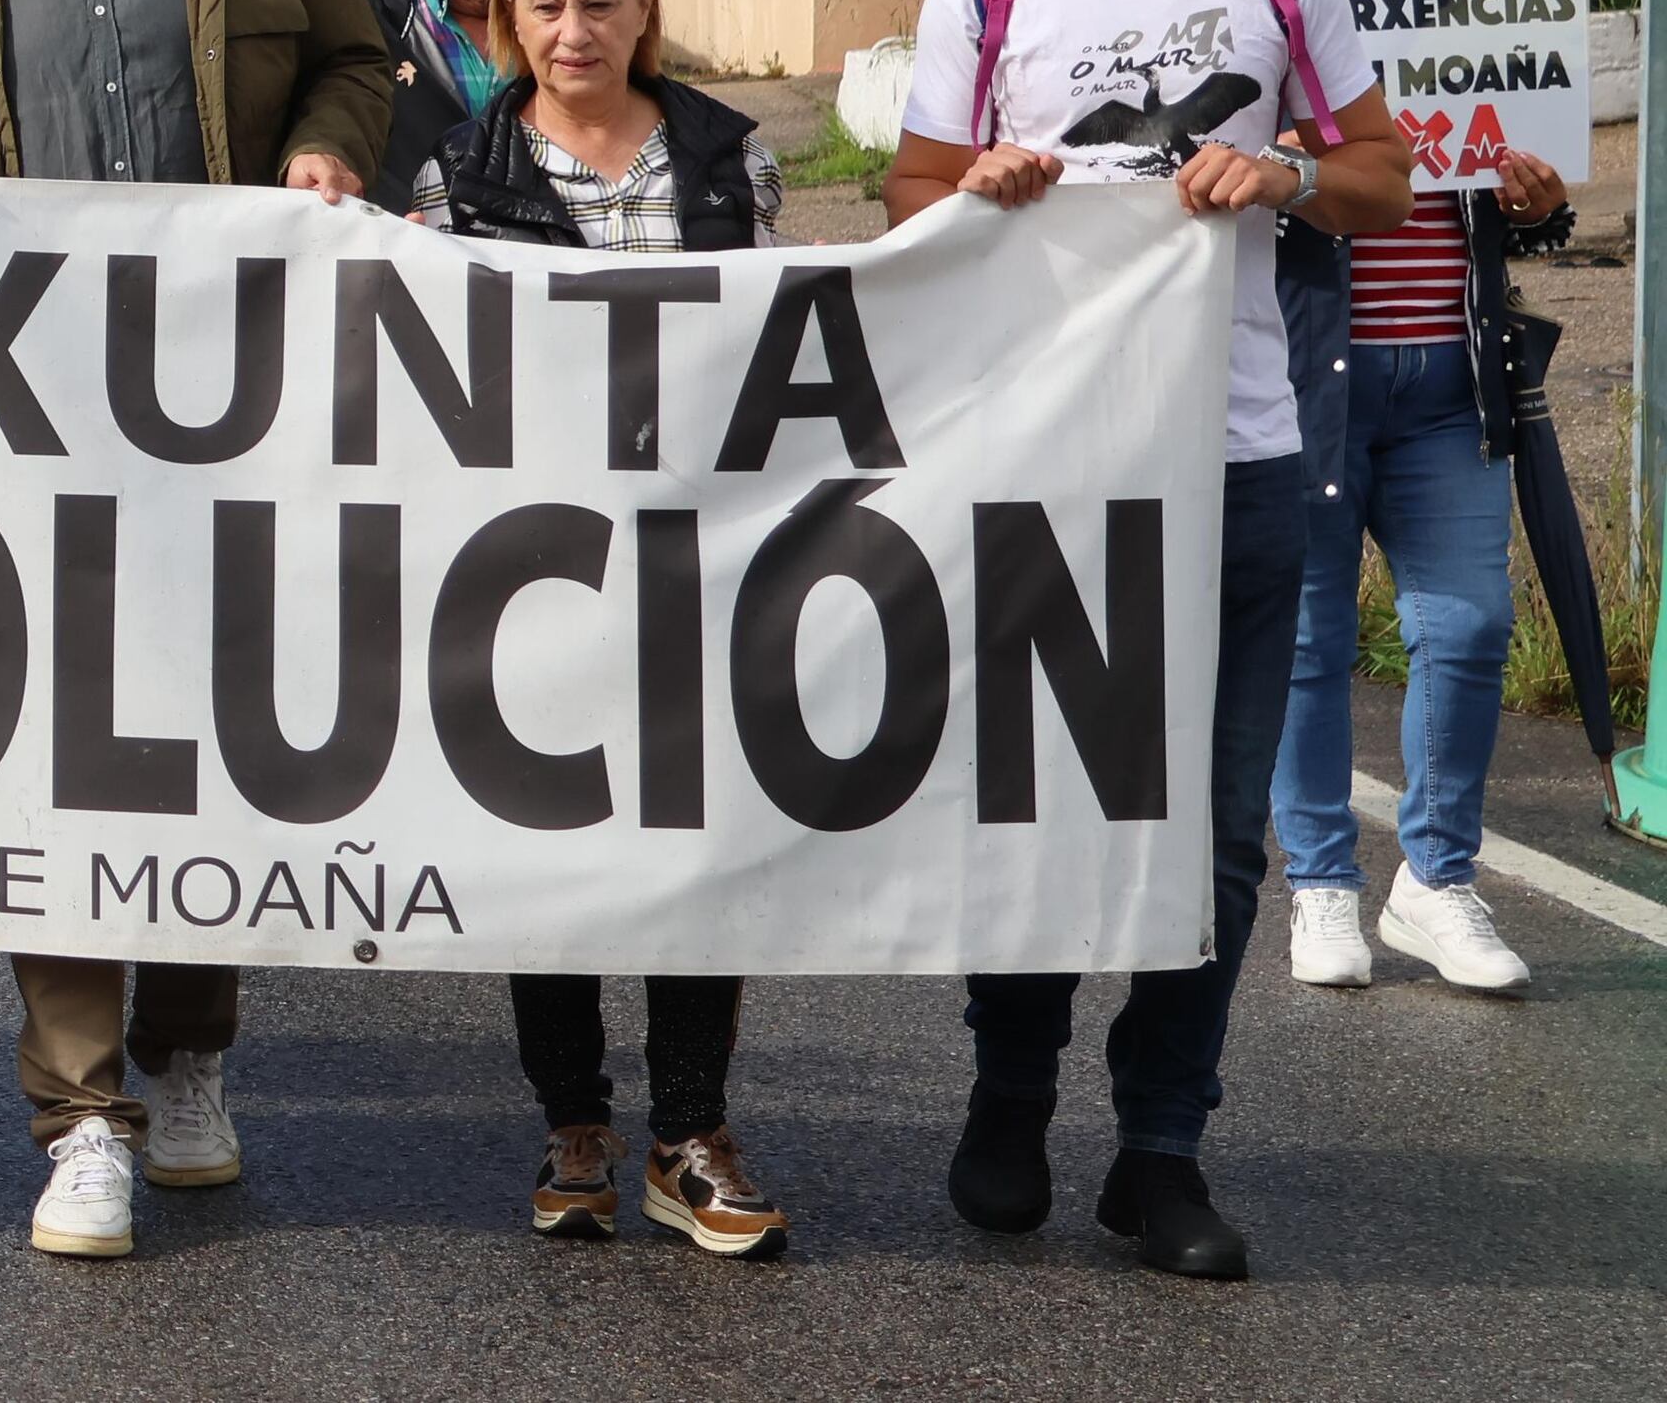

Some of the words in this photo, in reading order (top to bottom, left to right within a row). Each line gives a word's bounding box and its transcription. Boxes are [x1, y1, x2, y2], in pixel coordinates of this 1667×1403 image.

[1070, 61, 1095, 80] O
[1106, 48, 1196, 78] MAR
[1397, 44, 1572, 98] MOAÑA
[1090, 79, 1138, 95] MAR
[91, 841, 463, 934] MOAÑA
